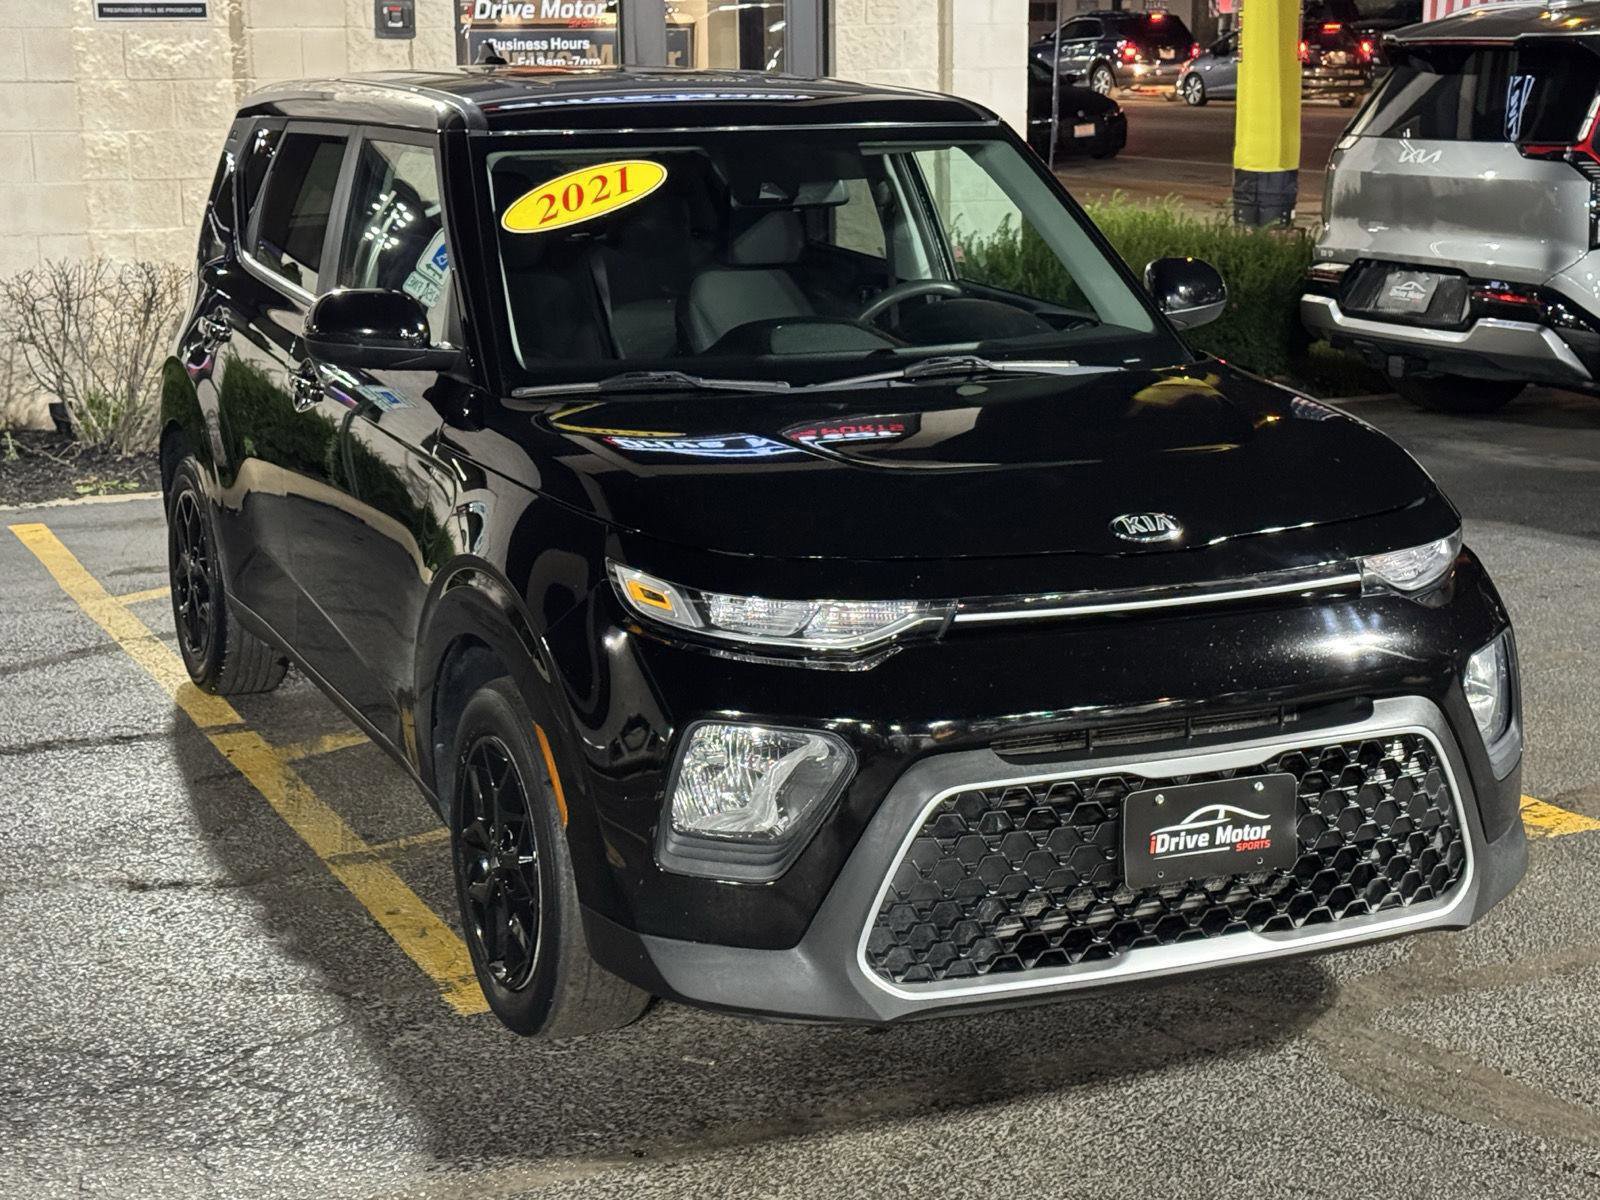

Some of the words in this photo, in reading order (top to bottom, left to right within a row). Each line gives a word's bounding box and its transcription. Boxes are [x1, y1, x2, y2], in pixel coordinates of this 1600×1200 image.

[541, 0, 607, 19] Motor
[551, 37, 590, 50] Hours
[536, 166, 633, 225] 2021
[1119, 514, 1178, 535] KIA
[1149, 831, 1210, 855] iDrive
[1215, 824, 1272, 845] Motor
[1235, 839, 1272, 852] SPORTS
